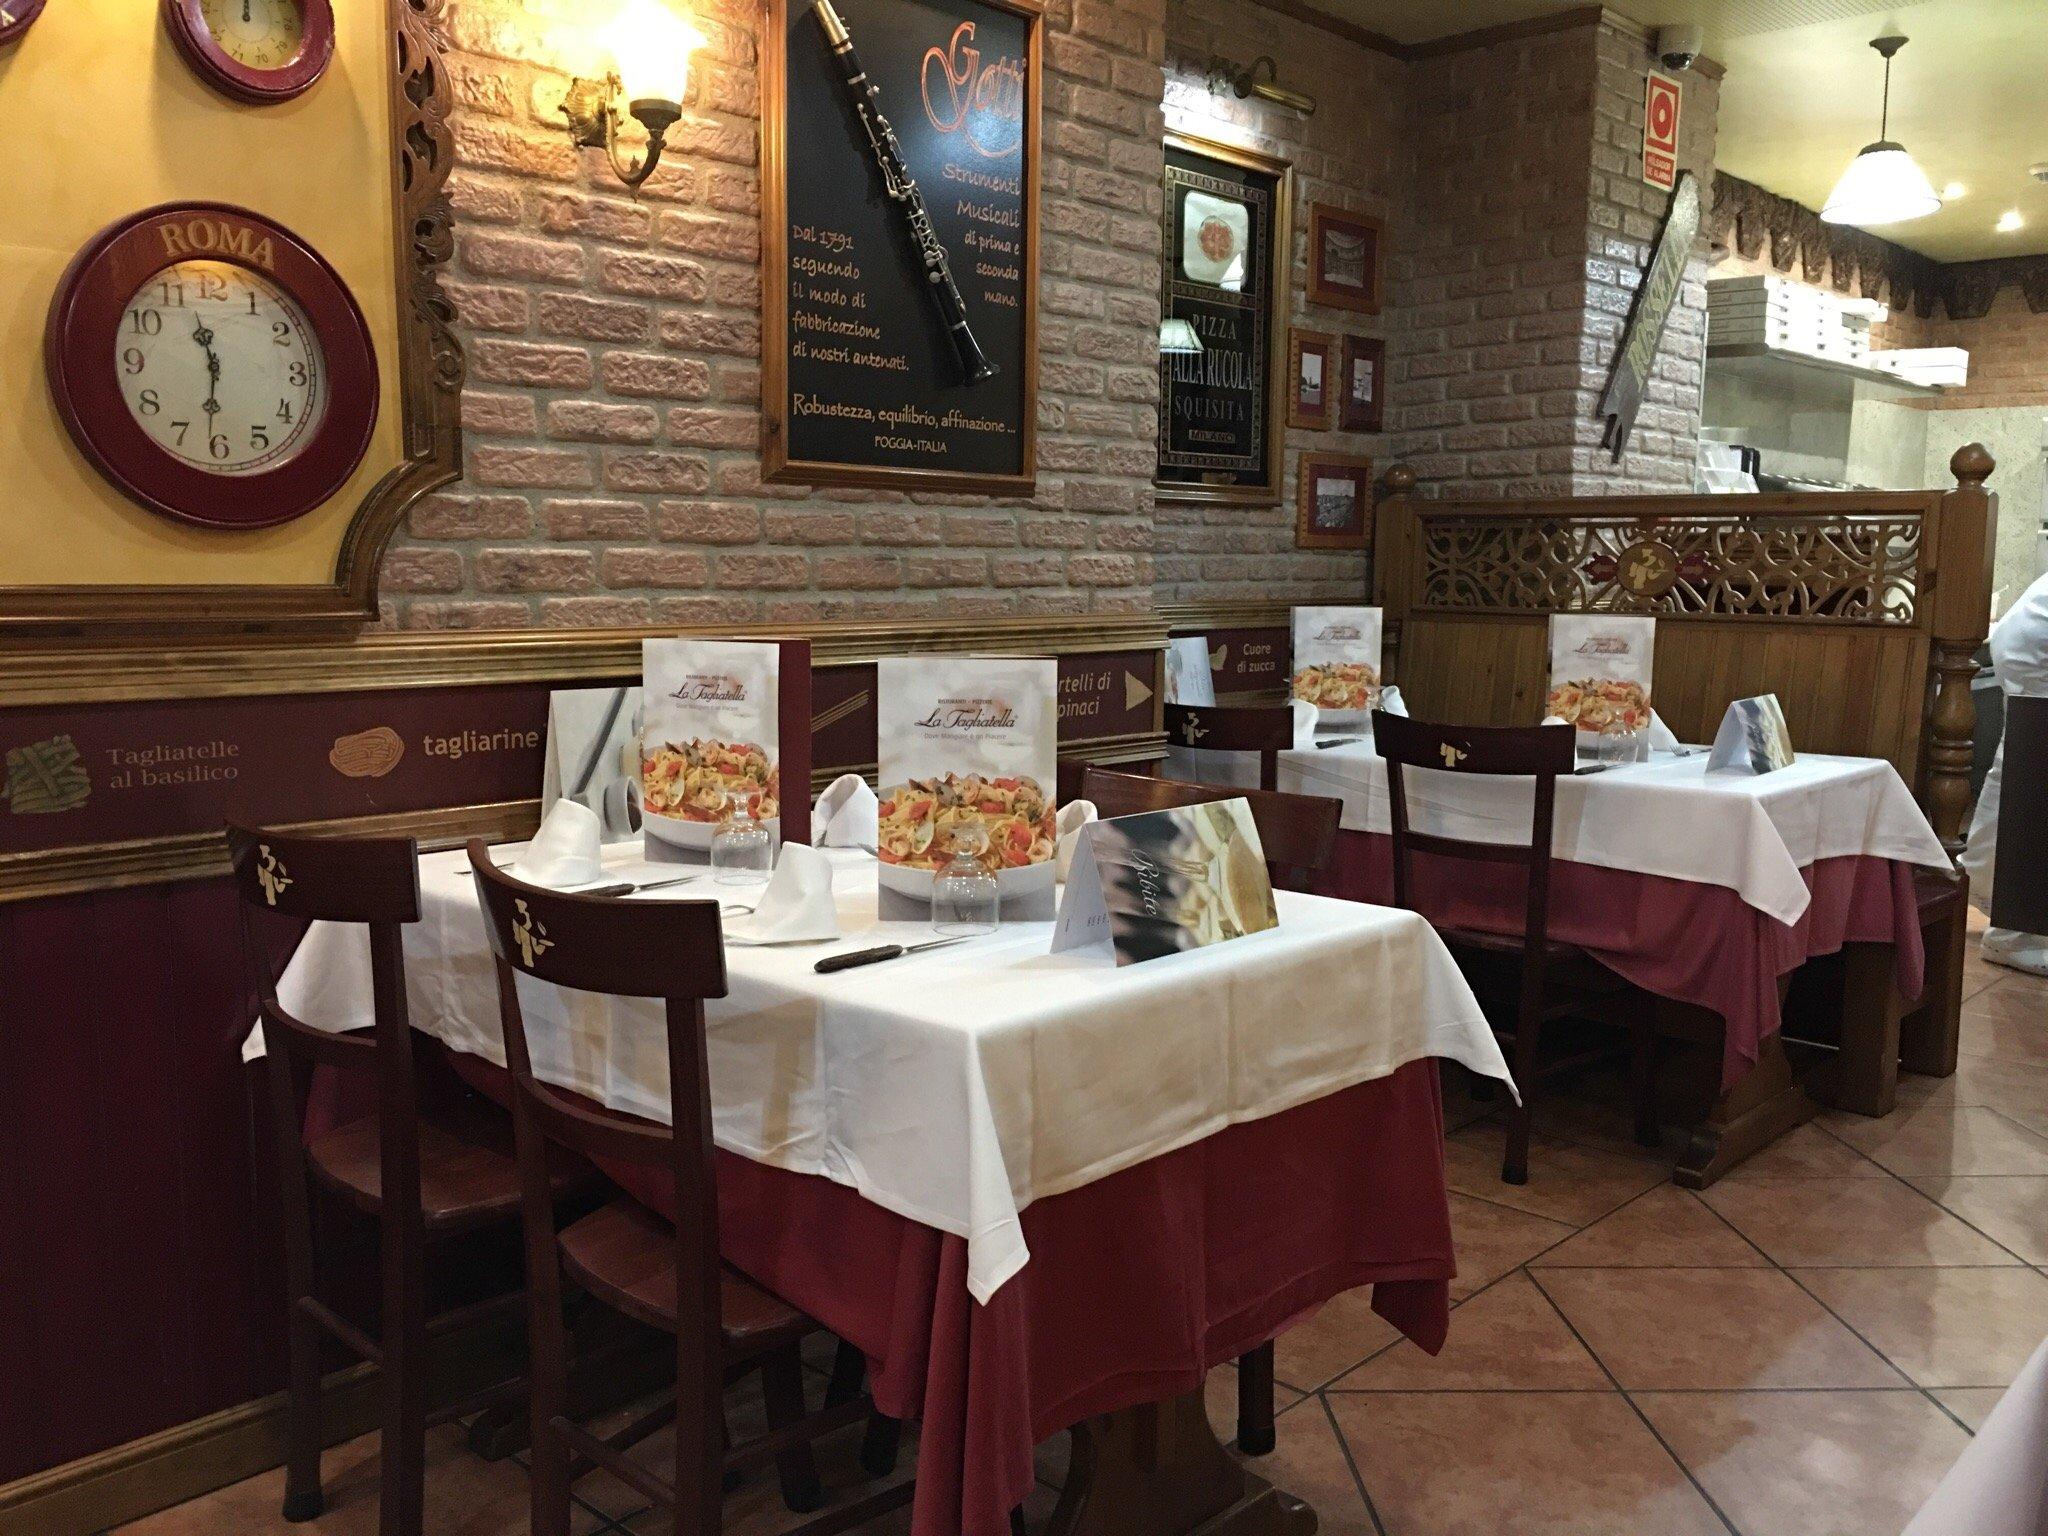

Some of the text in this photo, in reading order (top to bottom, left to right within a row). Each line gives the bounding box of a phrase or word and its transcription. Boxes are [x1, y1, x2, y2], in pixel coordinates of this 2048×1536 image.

[942, 163, 1021, 196] Strumenti
[957, 199, 1020, 229] Musicali
[156, 220, 278, 270] ROMA
[793, 224, 854, 253] Dal 1791
[965, 231, 1020, 255] di prima e
[792, 255, 860, 280] seguendo
[976, 261, 1019, 281] seconda
[157, 281, 185, 309] 11
[198, 277, 229, 302] 12
[793, 282, 866, 309] il modo di
[245, 292, 261, 316] 1
[131, 308, 162, 337] 10
[271, 321, 291, 348] 2
[792, 311, 881, 340] fabbricazione
[1192, 313, 1237, 340] PIZZA
[123, 348, 144, 375] 9
[793, 341, 909, 371] di nostri antenati.
[1172, 348, 1253, 391] ALLA RUCOLA
[289, 361, 308, 387] 3
[139, 389, 160, 416] 8
[275, 398, 293, 425] 4
[793, 393, 876, 423] Robustezza,
[878, 403, 939, 429] equilibrio,
[1175, 395, 1244, 422] SQUISITA
[170, 420, 191, 447] 7
[208, 433, 230, 460] 6
[250, 425, 269, 451] 5
[1191, 429, 1233, 442] MILANO
[1243, 643, 1272, 657] Cuore
[1237, 660, 1275, 674] di zucca
[669, 681, 746, 703] La Tagliatella
[1058, 671, 1111, 693] rtelli di
[914, 707, 1016, 731] La Tagliatella
[1057, 696, 1100, 719] pinaci
[105, 741, 240, 767] Tagliatelle
[423, 728, 539, 760] tagliarine
[110, 765, 239, 789] al basilico
